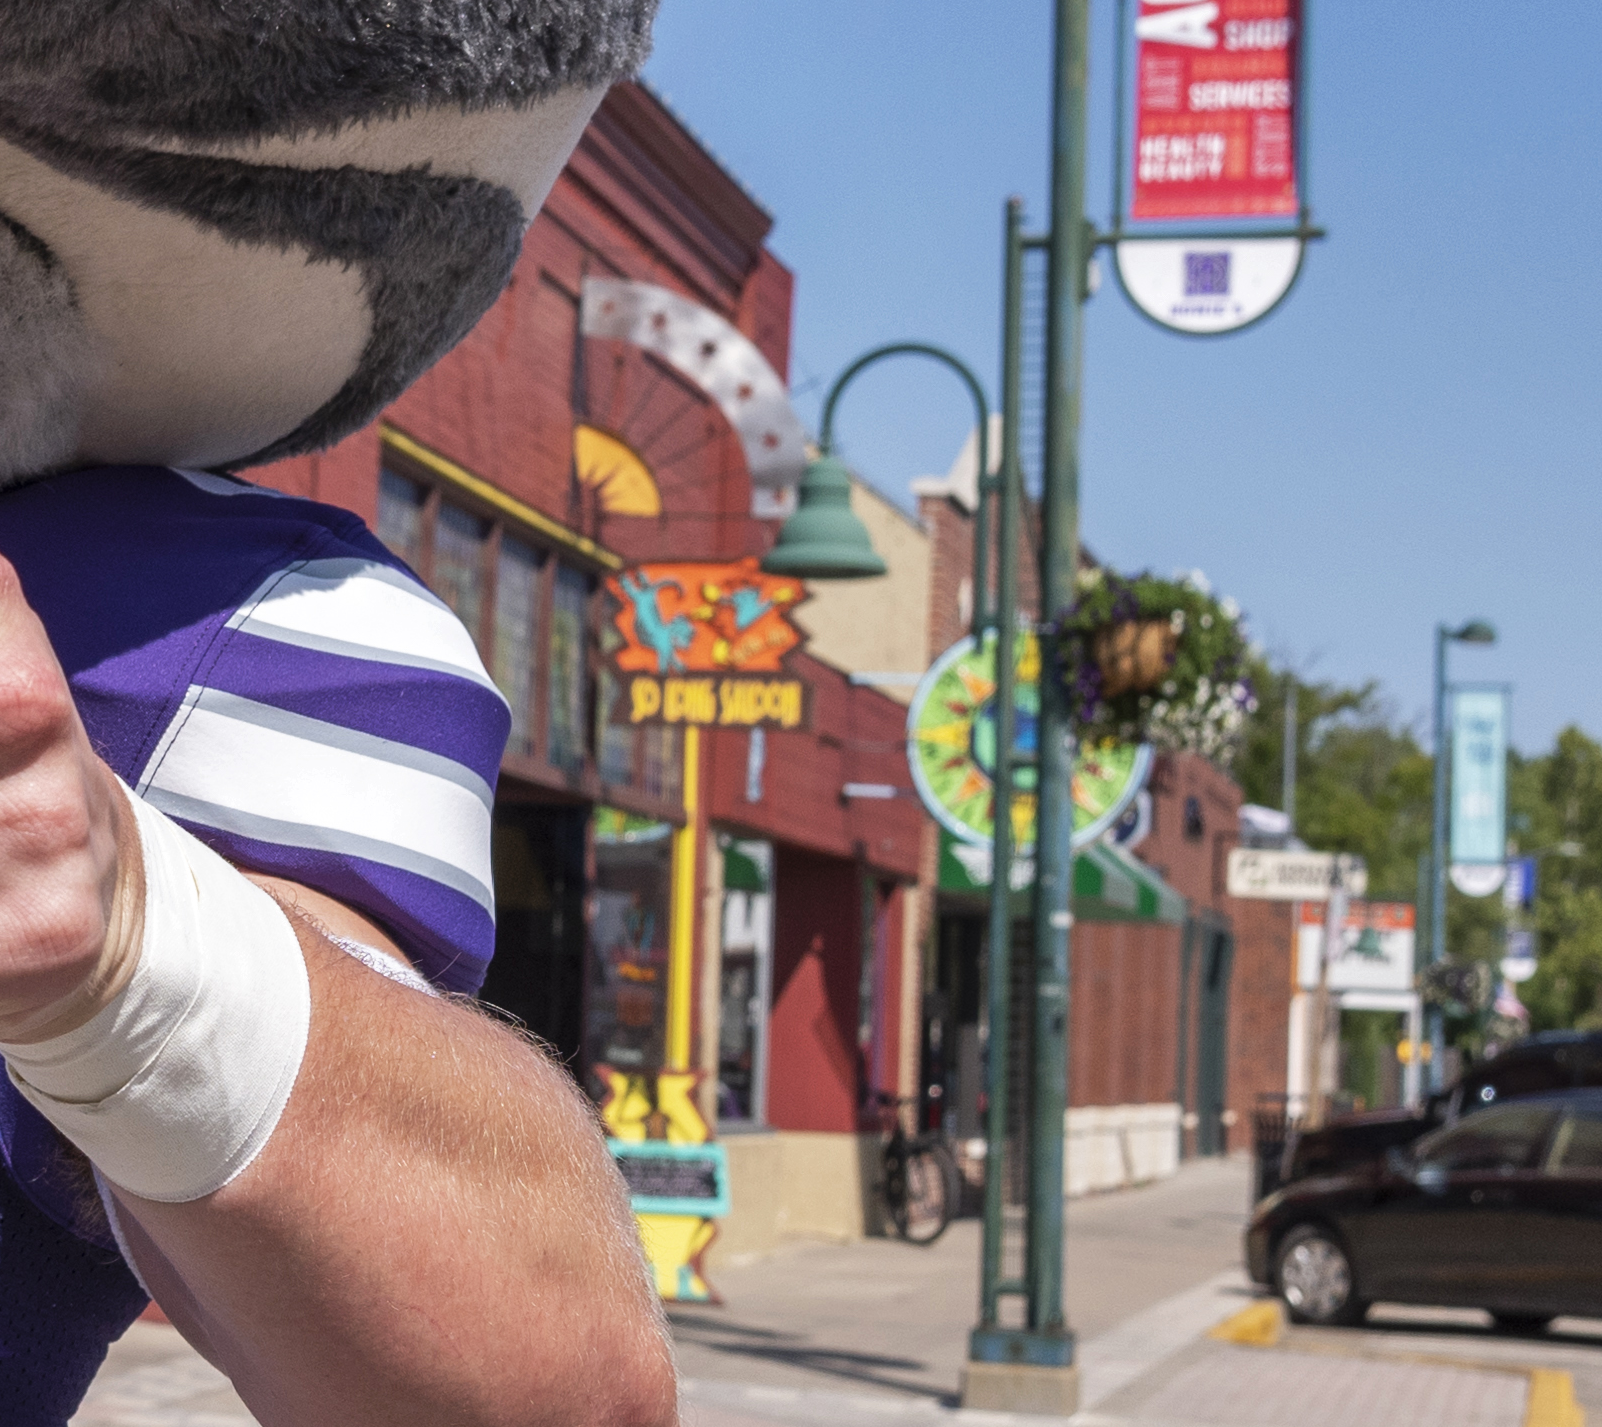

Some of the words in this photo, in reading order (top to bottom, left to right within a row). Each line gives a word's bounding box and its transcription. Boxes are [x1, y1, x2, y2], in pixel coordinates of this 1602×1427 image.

[1224, 17, 1292, 51] SHOP
[1189, 79, 1292, 111] SERVICES
[1140, 132, 1225, 160] HEALTH
[630, 677, 662, 723] SO
[663, 678, 717, 724] LONG
[718, 679, 803, 728] SALOON
